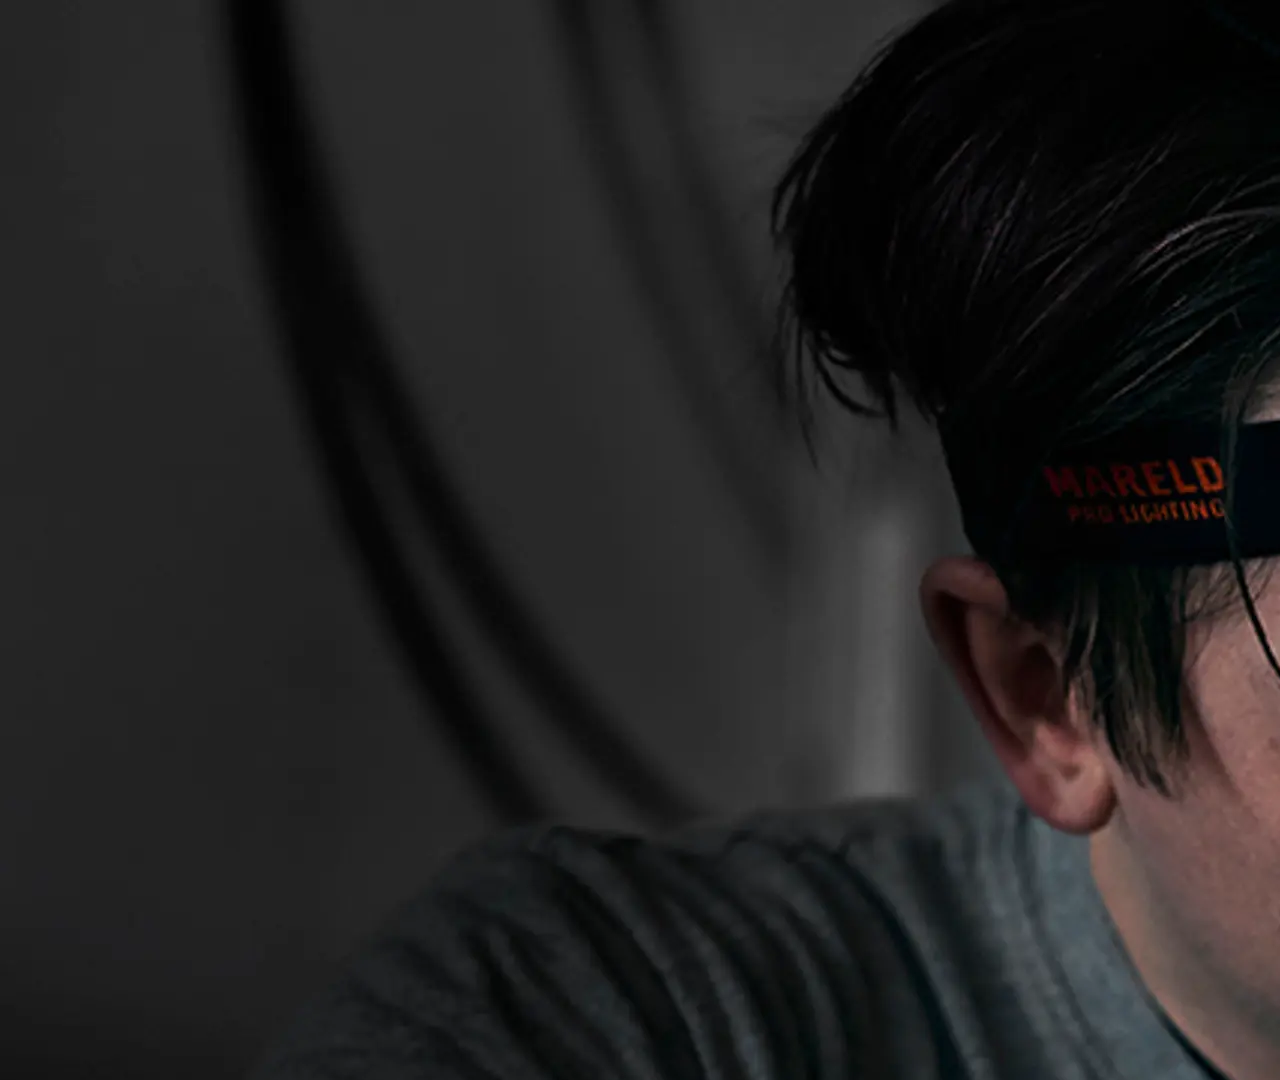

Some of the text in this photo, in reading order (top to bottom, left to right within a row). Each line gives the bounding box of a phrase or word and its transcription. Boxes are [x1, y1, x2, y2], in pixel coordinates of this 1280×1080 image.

[1042, 455, 1225, 499] MARELD
[1067, 497, 1226, 525] PRO LIGHTING
